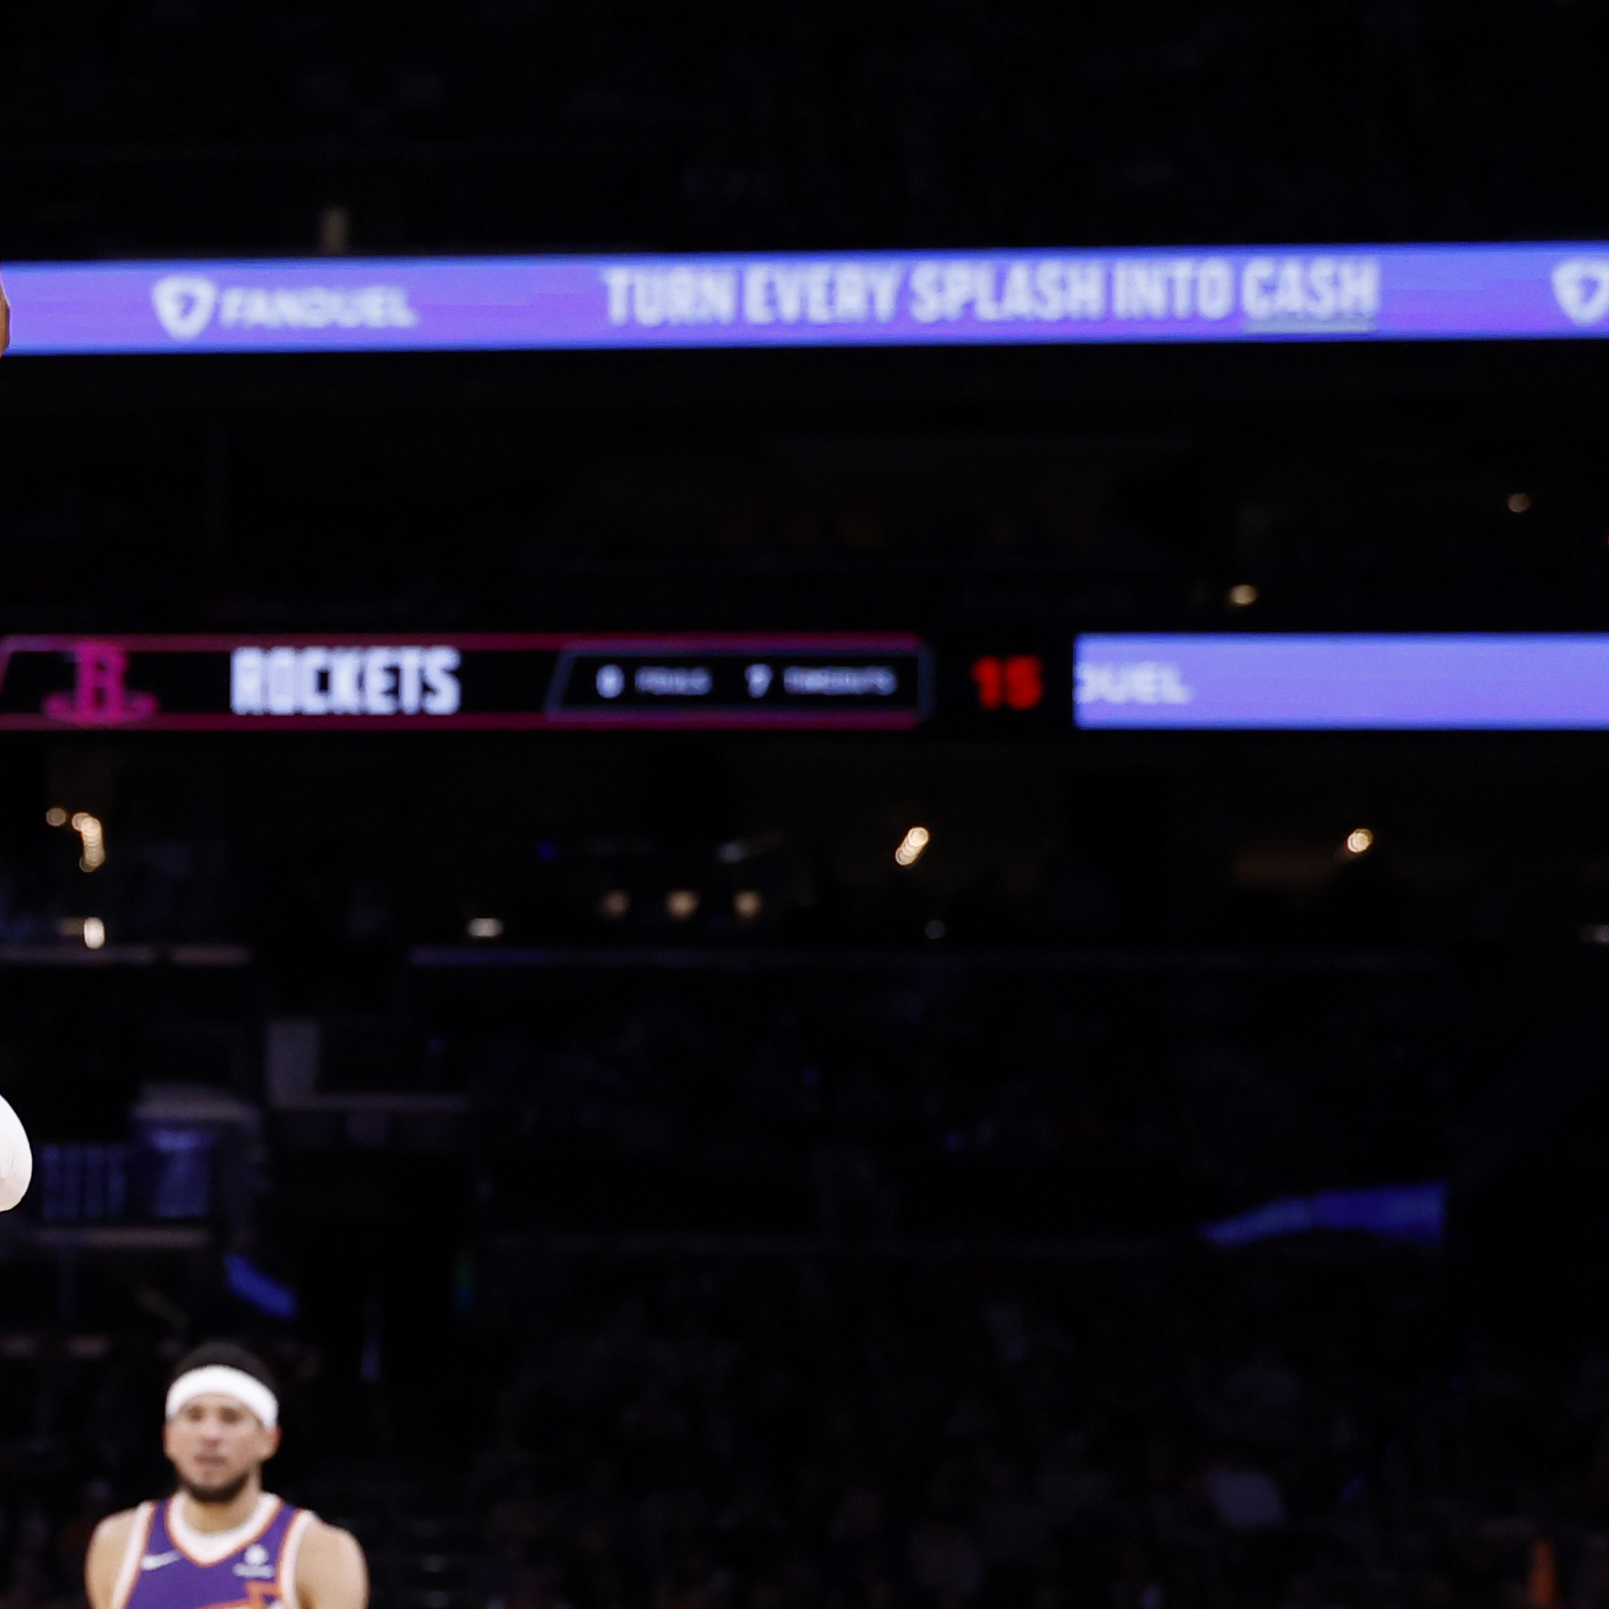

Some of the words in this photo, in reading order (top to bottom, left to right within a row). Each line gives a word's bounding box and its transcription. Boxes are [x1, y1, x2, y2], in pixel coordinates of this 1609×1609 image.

[601, 265, 736, 326] TURN
[743, 263, 902, 324] EVERY
[909, 260, 1103, 322] SPLASH
[1111, 257, 1232, 319] INTO
[1240, 257, 1380, 319] CASH
[231, 646, 460, 715] ROCKETS
